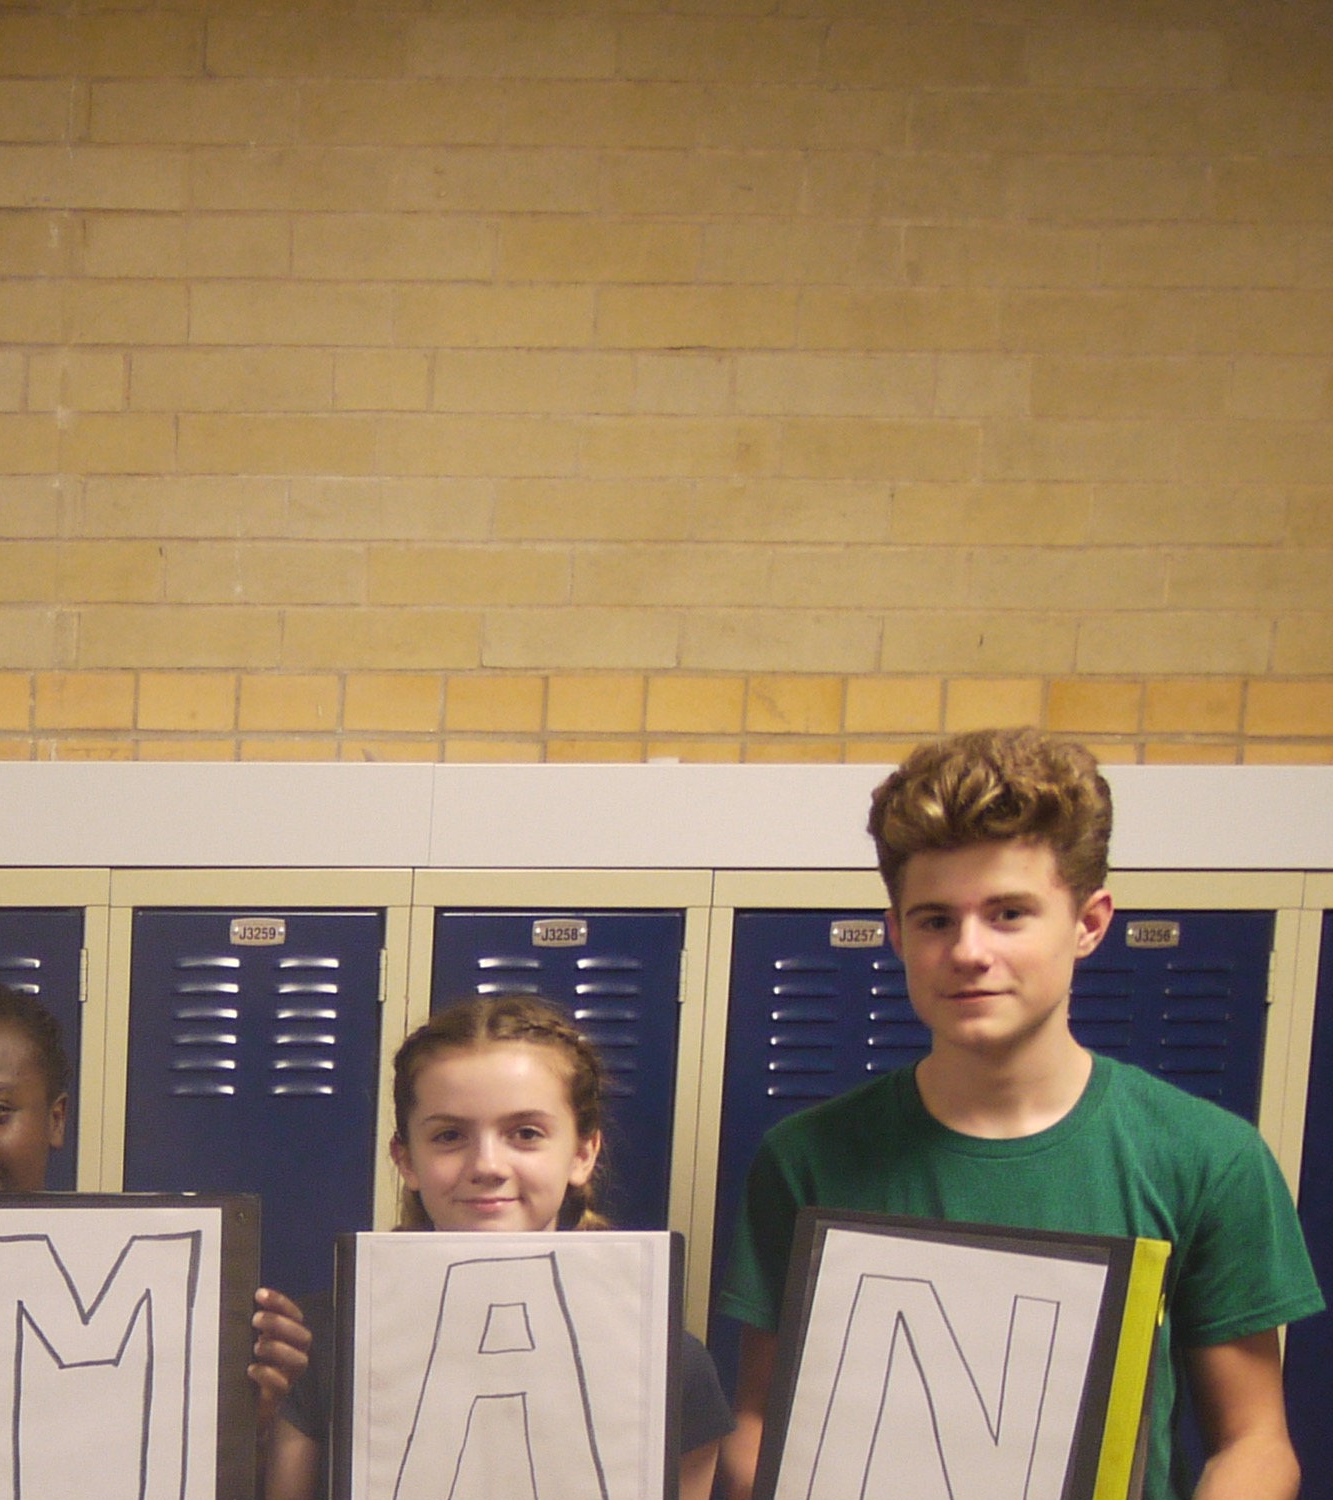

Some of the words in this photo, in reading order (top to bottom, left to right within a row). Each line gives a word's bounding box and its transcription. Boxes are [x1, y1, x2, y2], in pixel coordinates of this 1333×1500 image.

[239, 926, 276, 940] J3259
[542, 927, 578, 941] J3258
[839, 928, 875, 942] J3257
